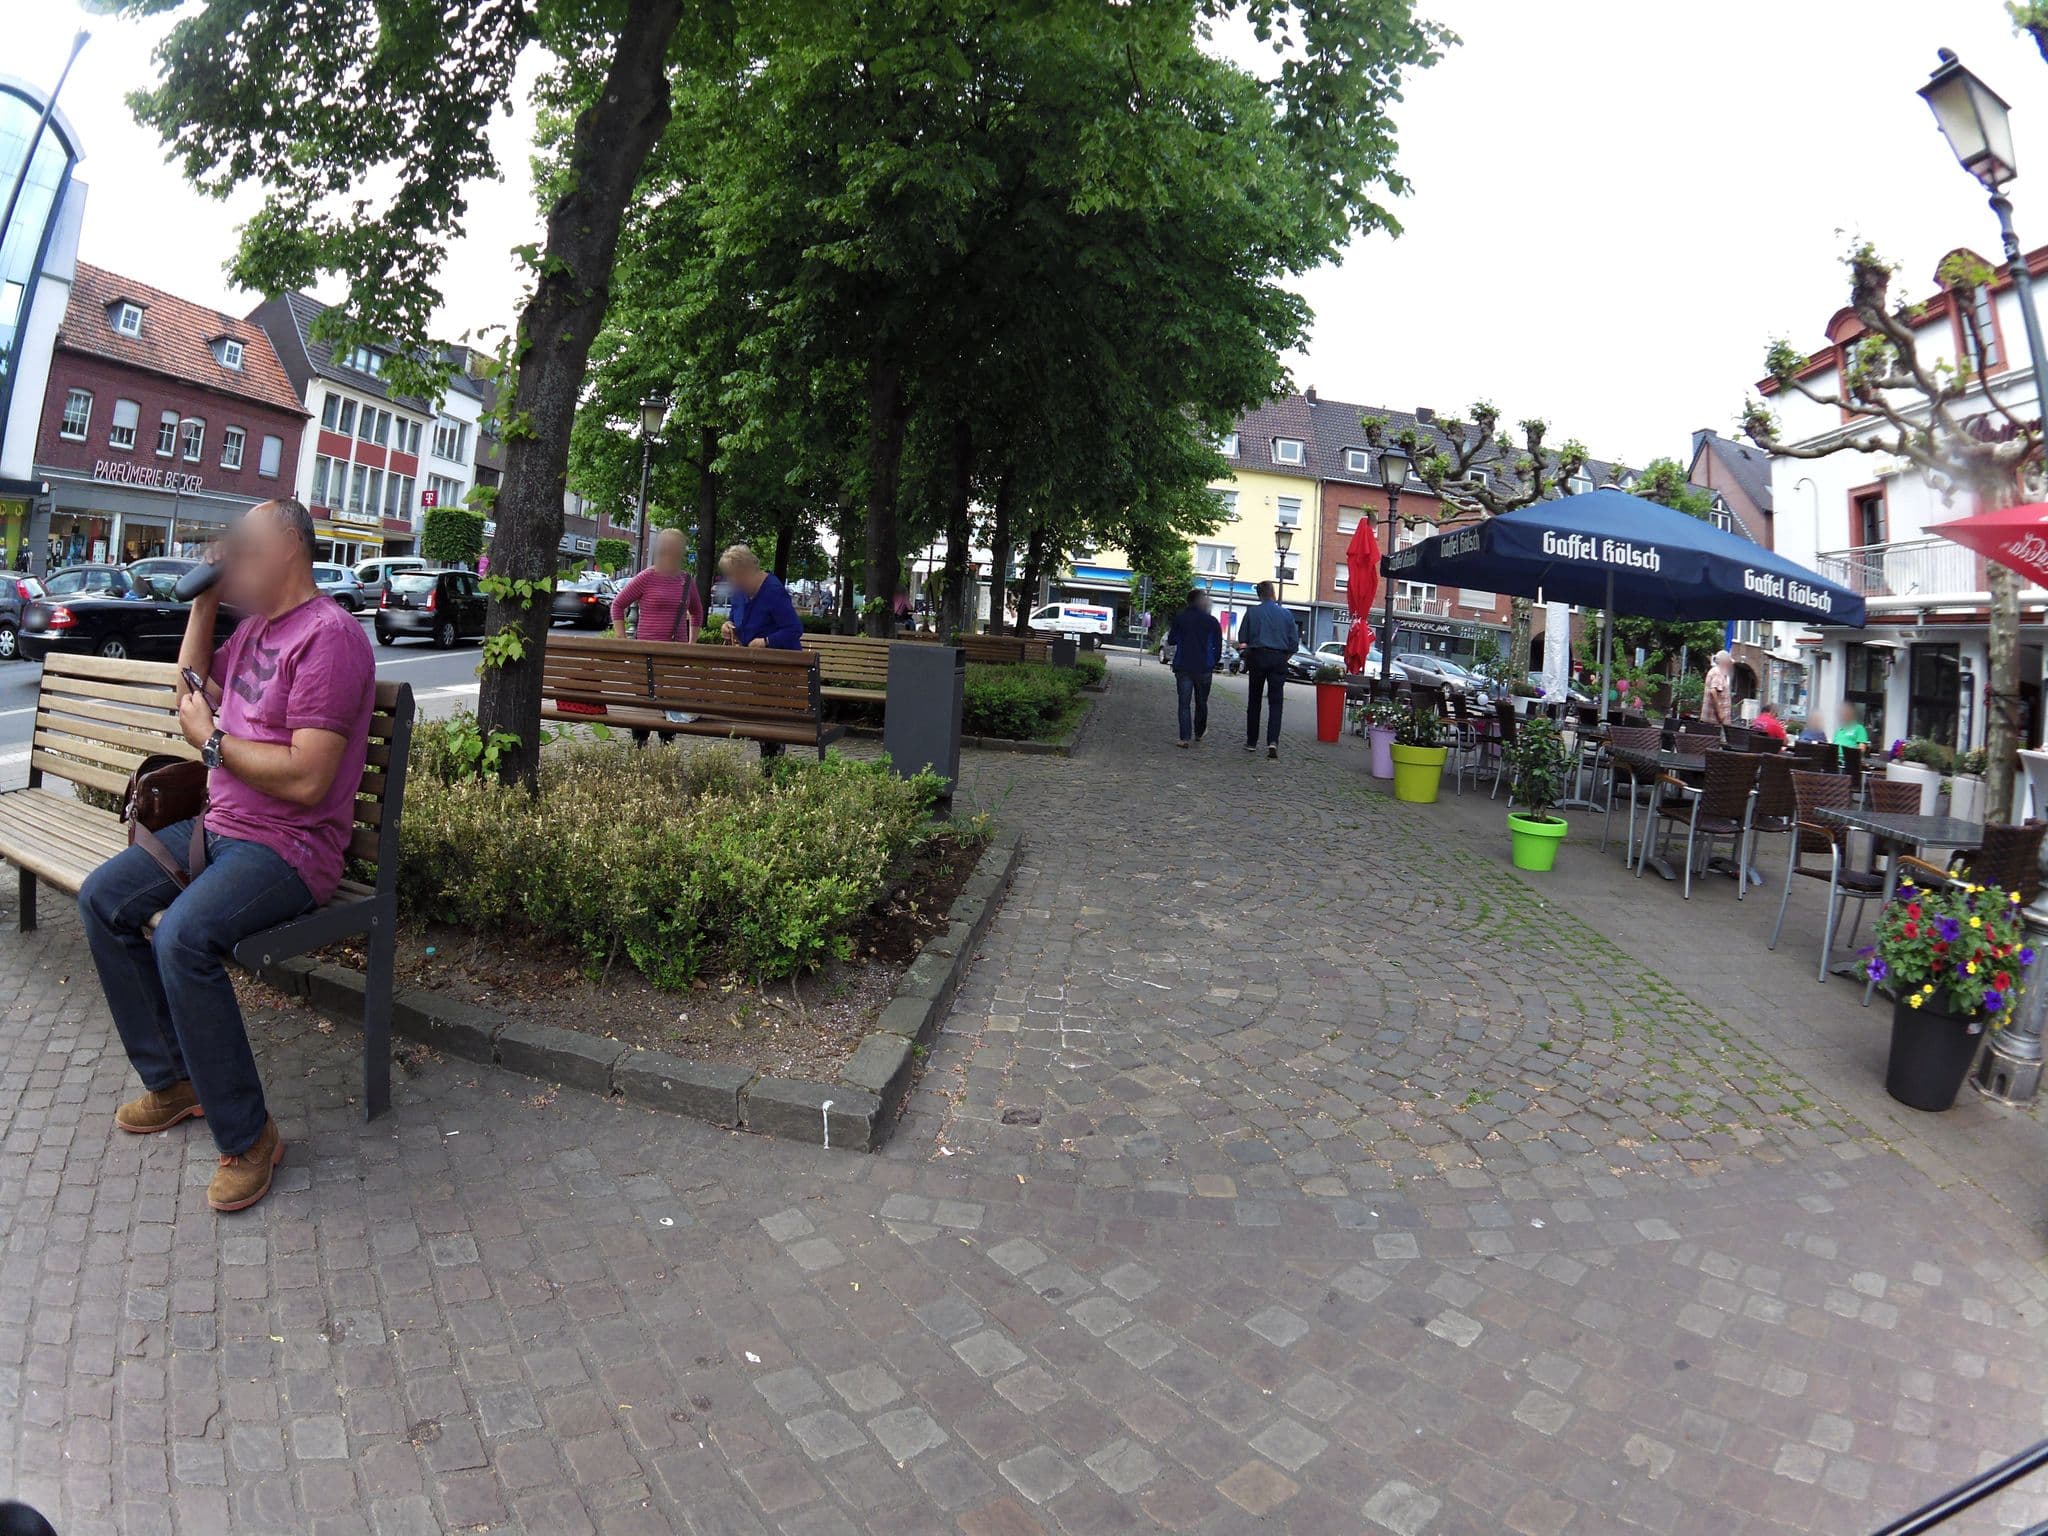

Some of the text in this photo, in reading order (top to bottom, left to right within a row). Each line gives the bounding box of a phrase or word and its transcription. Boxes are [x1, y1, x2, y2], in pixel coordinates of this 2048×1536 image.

[94, 460, 163, 487] PARFÜMERIE
[1543, 530, 1660, 572] Gaffel Kölsch
[1744, 568, 1832, 613] Gaffel Kölsch
